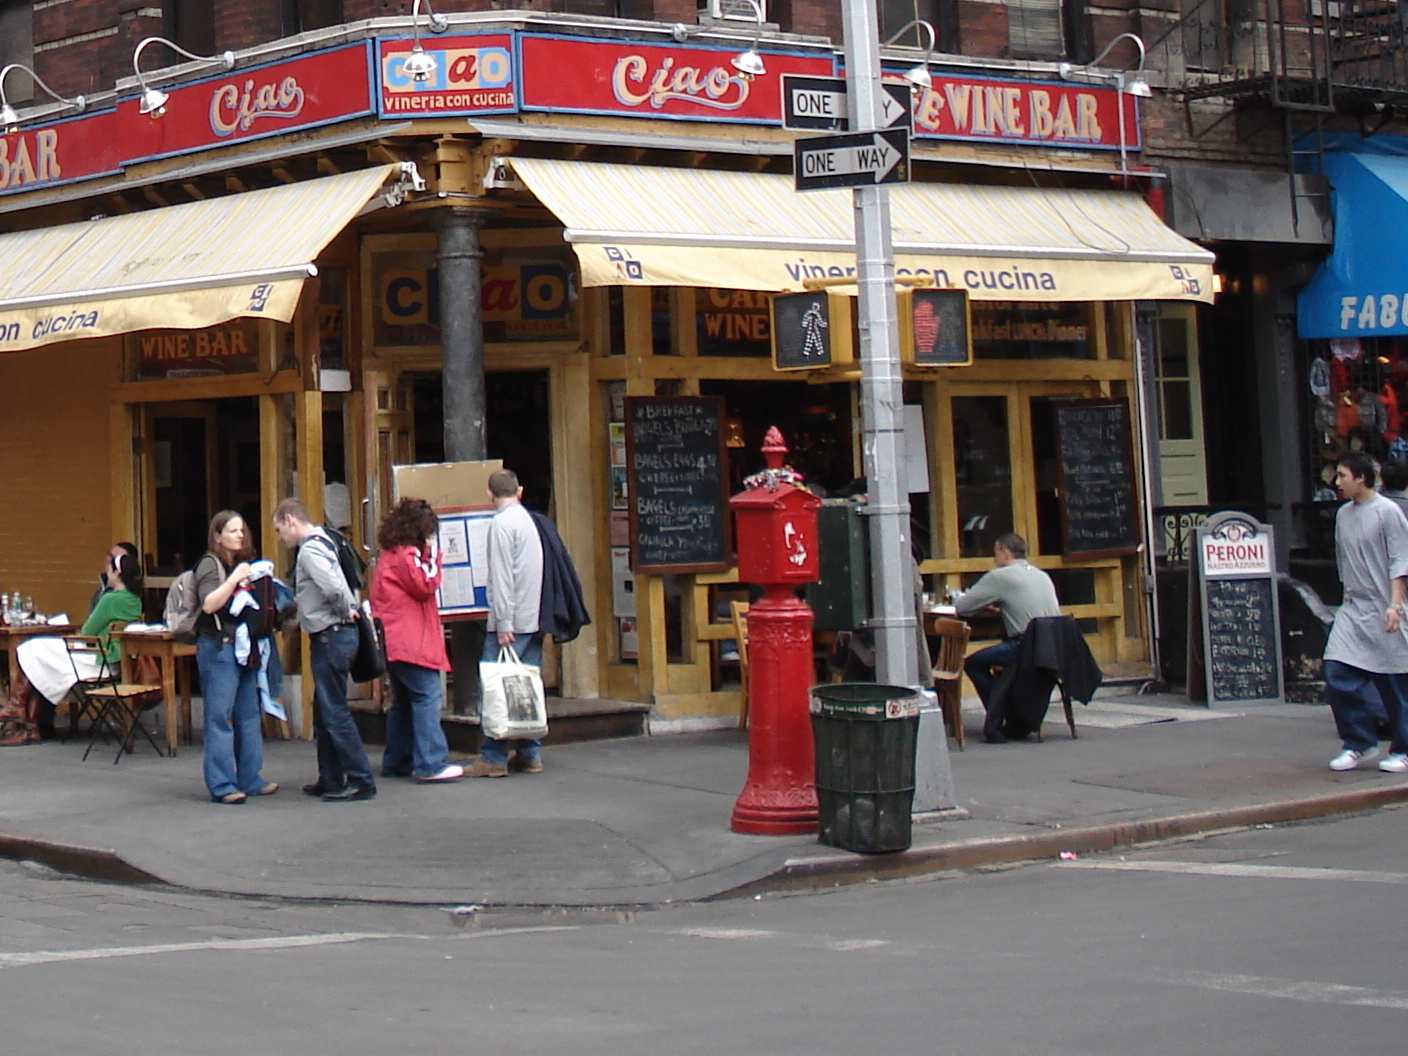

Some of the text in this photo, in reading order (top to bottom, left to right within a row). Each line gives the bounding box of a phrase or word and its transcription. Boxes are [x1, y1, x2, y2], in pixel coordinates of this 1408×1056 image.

[612, 55, 750, 110] Ciao
[209, 76, 305, 137] Ciao
[385, 92, 514, 110] vineria con cucina
[796, 93, 833, 115] ONE
[944, 83, 1025, 136] WINE
[1029, 90, 1102, 143] BAR
[805, 147, 889, 174] ONE WAY
[785, 259, 857, 283] viner
[963, 266, 1057, 291] cucina
[32, 310, 99, 340] cucina
[704, 313, 770, 341] WINE
[142, 330, 249, 360] WINE BAR
[1206, 544, 1265, 562] PERONI
